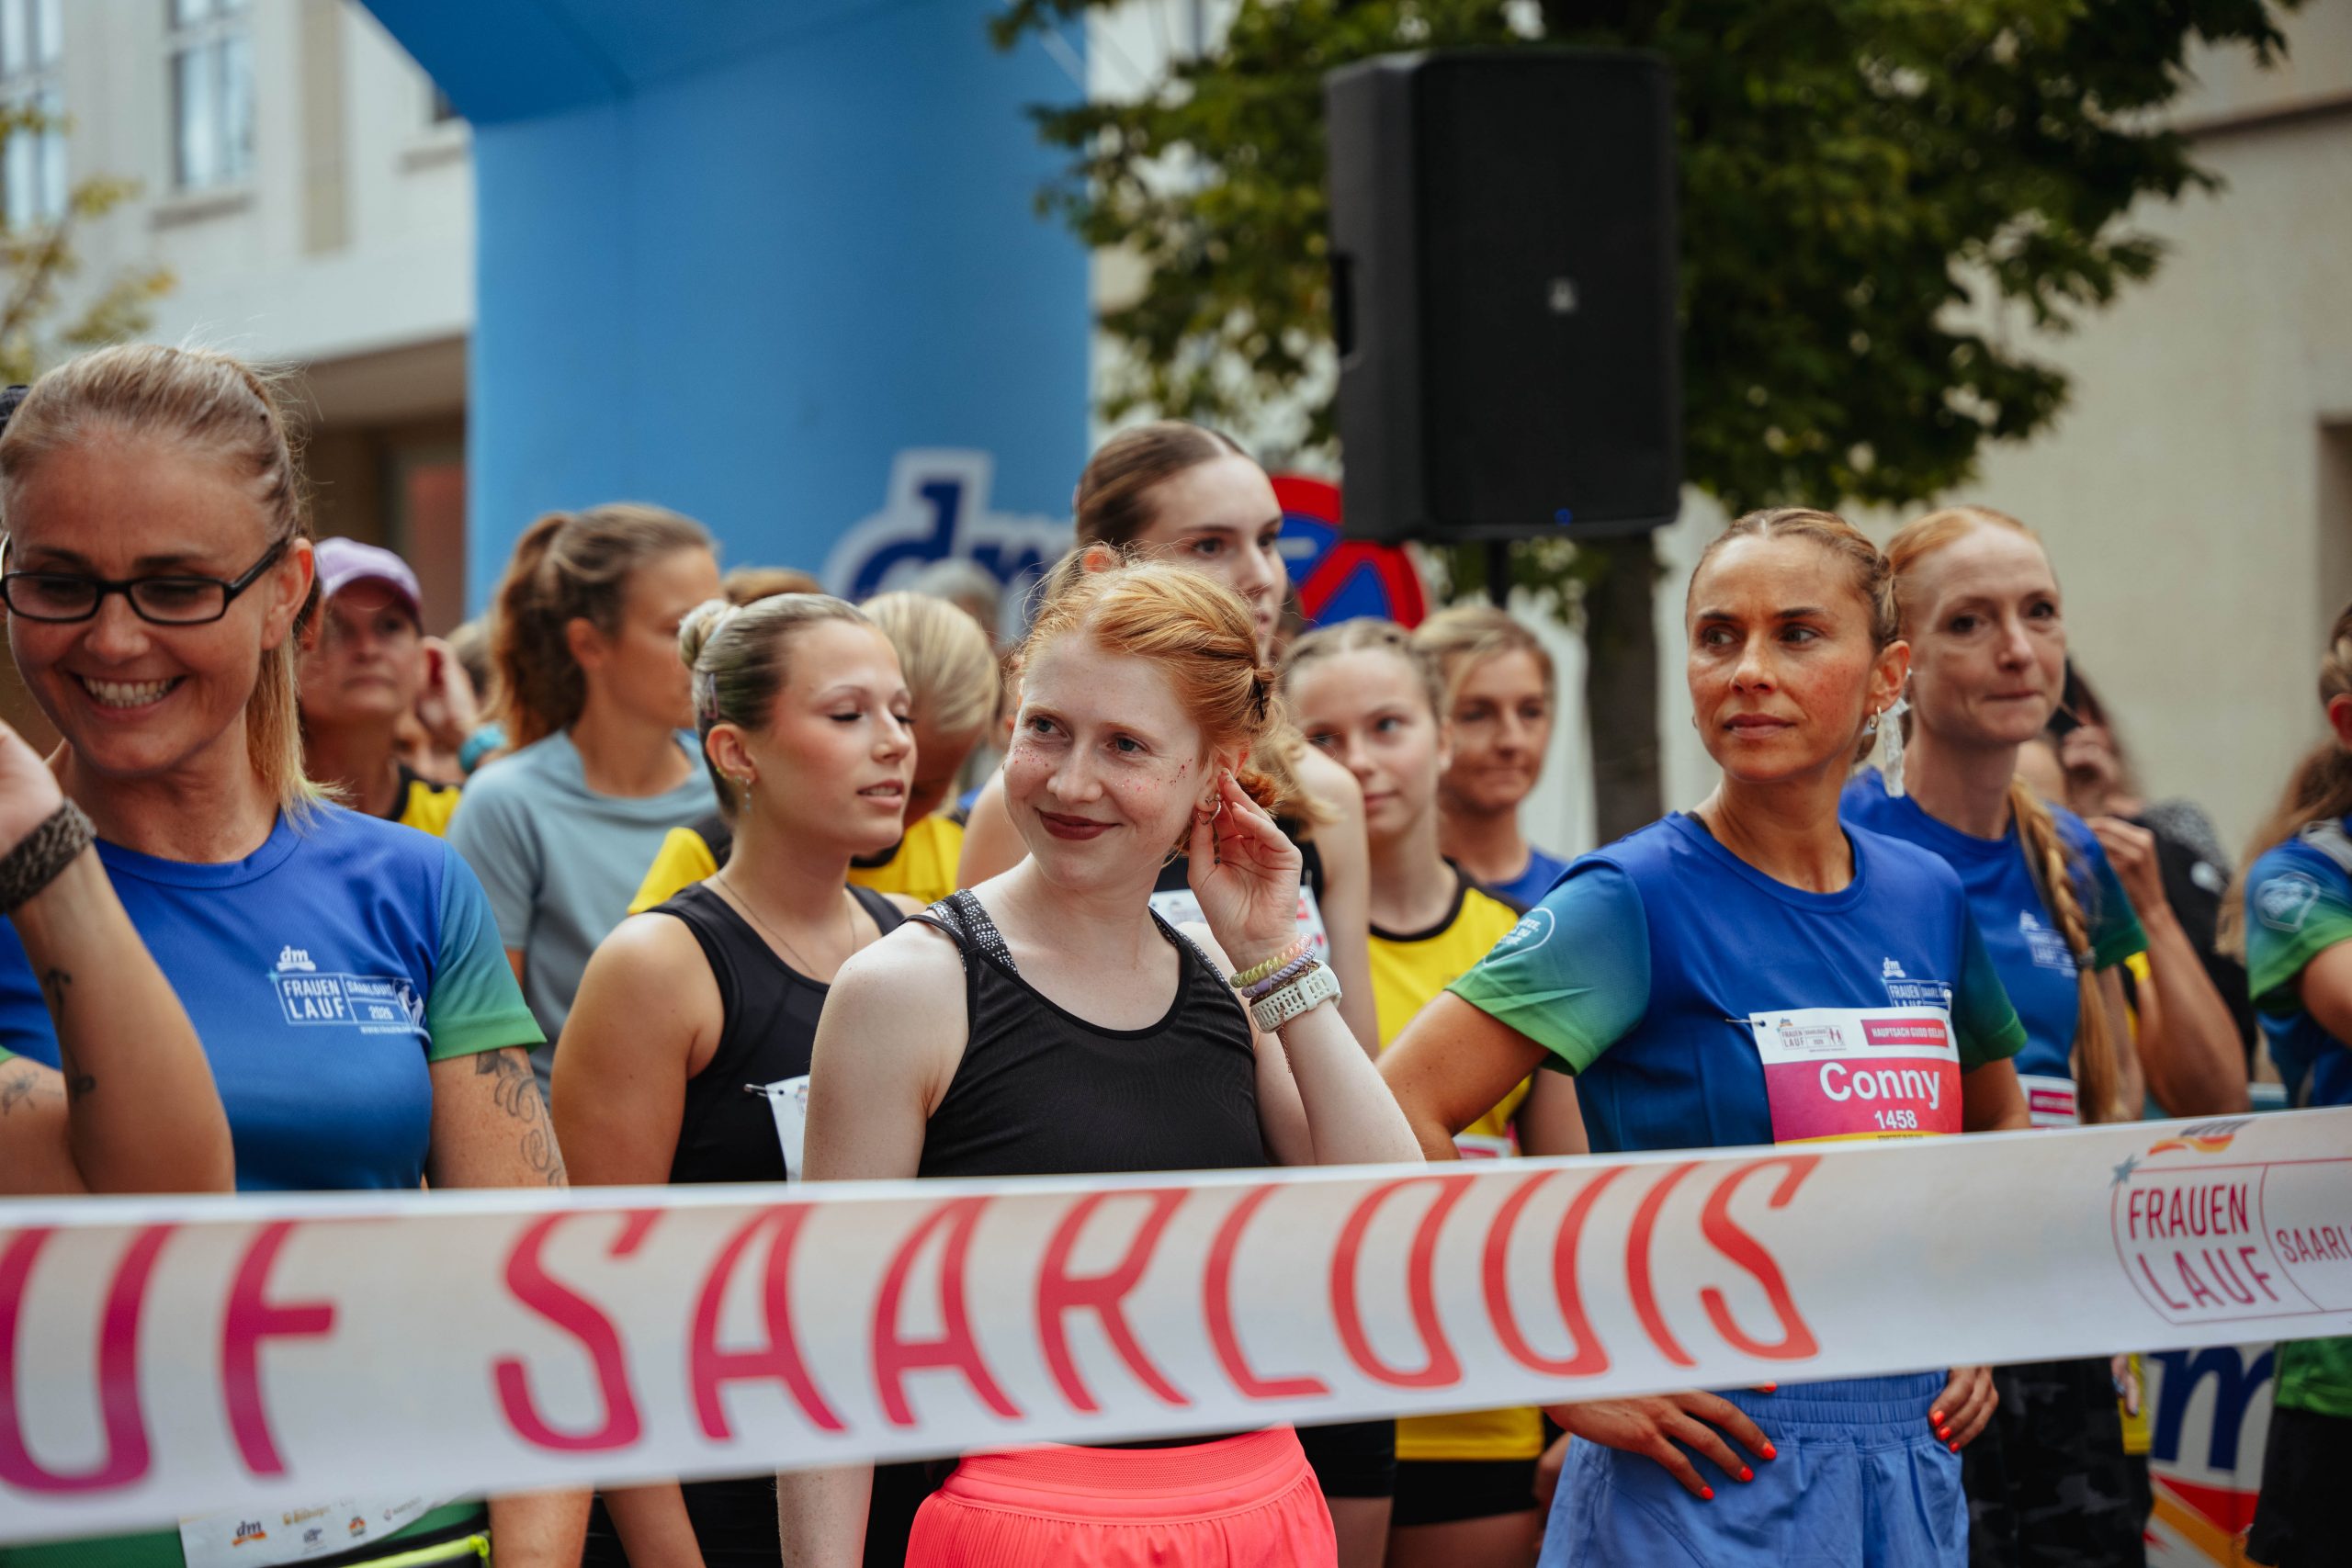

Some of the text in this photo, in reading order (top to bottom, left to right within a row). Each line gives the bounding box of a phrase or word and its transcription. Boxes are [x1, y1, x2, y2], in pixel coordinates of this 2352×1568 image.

[279, 944, 309, 964] dm
[282, 978, 341, 998] FRAUEN
[1889, 984, 1921, 999] FRAUEN
[288, 997, 345, 1020] LAUF
[1781, 1029, 1804, 1039] FRAUEN
[1783, 1036, 1805, 1048] LAUF
[1819, 1061, 1940, 1111] Conny
[1874, 1109, 1918, 1130] 1458
[2128, 1182, 2250, 1240] FRAUEN
[2275, 1224, 2352, 1264] SAARL
[2136, 1246, 2280, 1311] LAUF
[492, 1156, 1823, 1455] SAARLOUIS
[235, 1519, 263, 1539] dm
